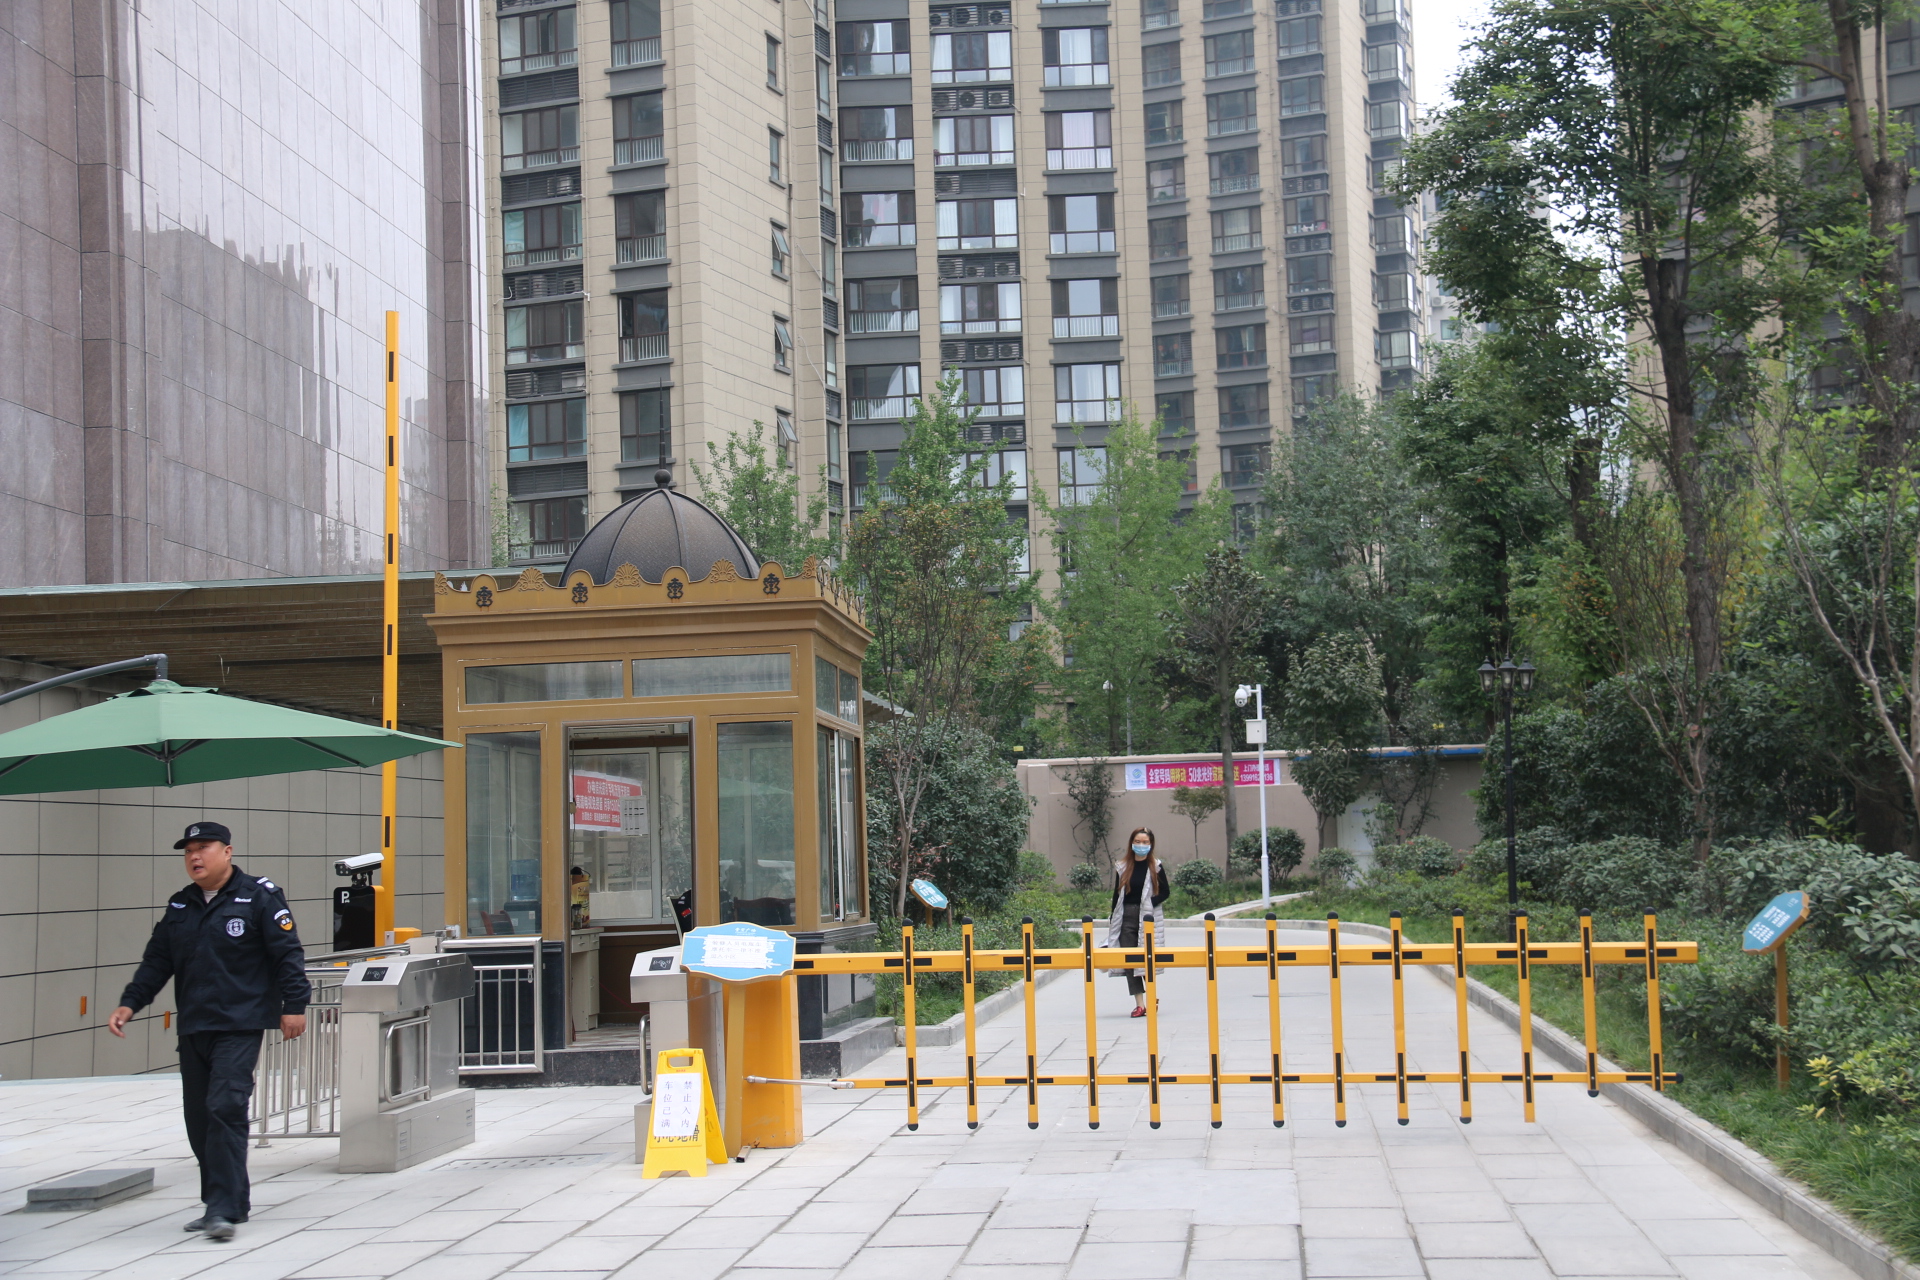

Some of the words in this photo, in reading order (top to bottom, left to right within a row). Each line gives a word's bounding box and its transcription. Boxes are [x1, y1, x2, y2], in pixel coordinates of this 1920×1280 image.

[1188, 765, 1240, 782] 50兆光纤宽带送
[1240, 772, 1273, 782] 1399162136
[681, 1081, 692, 1128] 禁止入内
